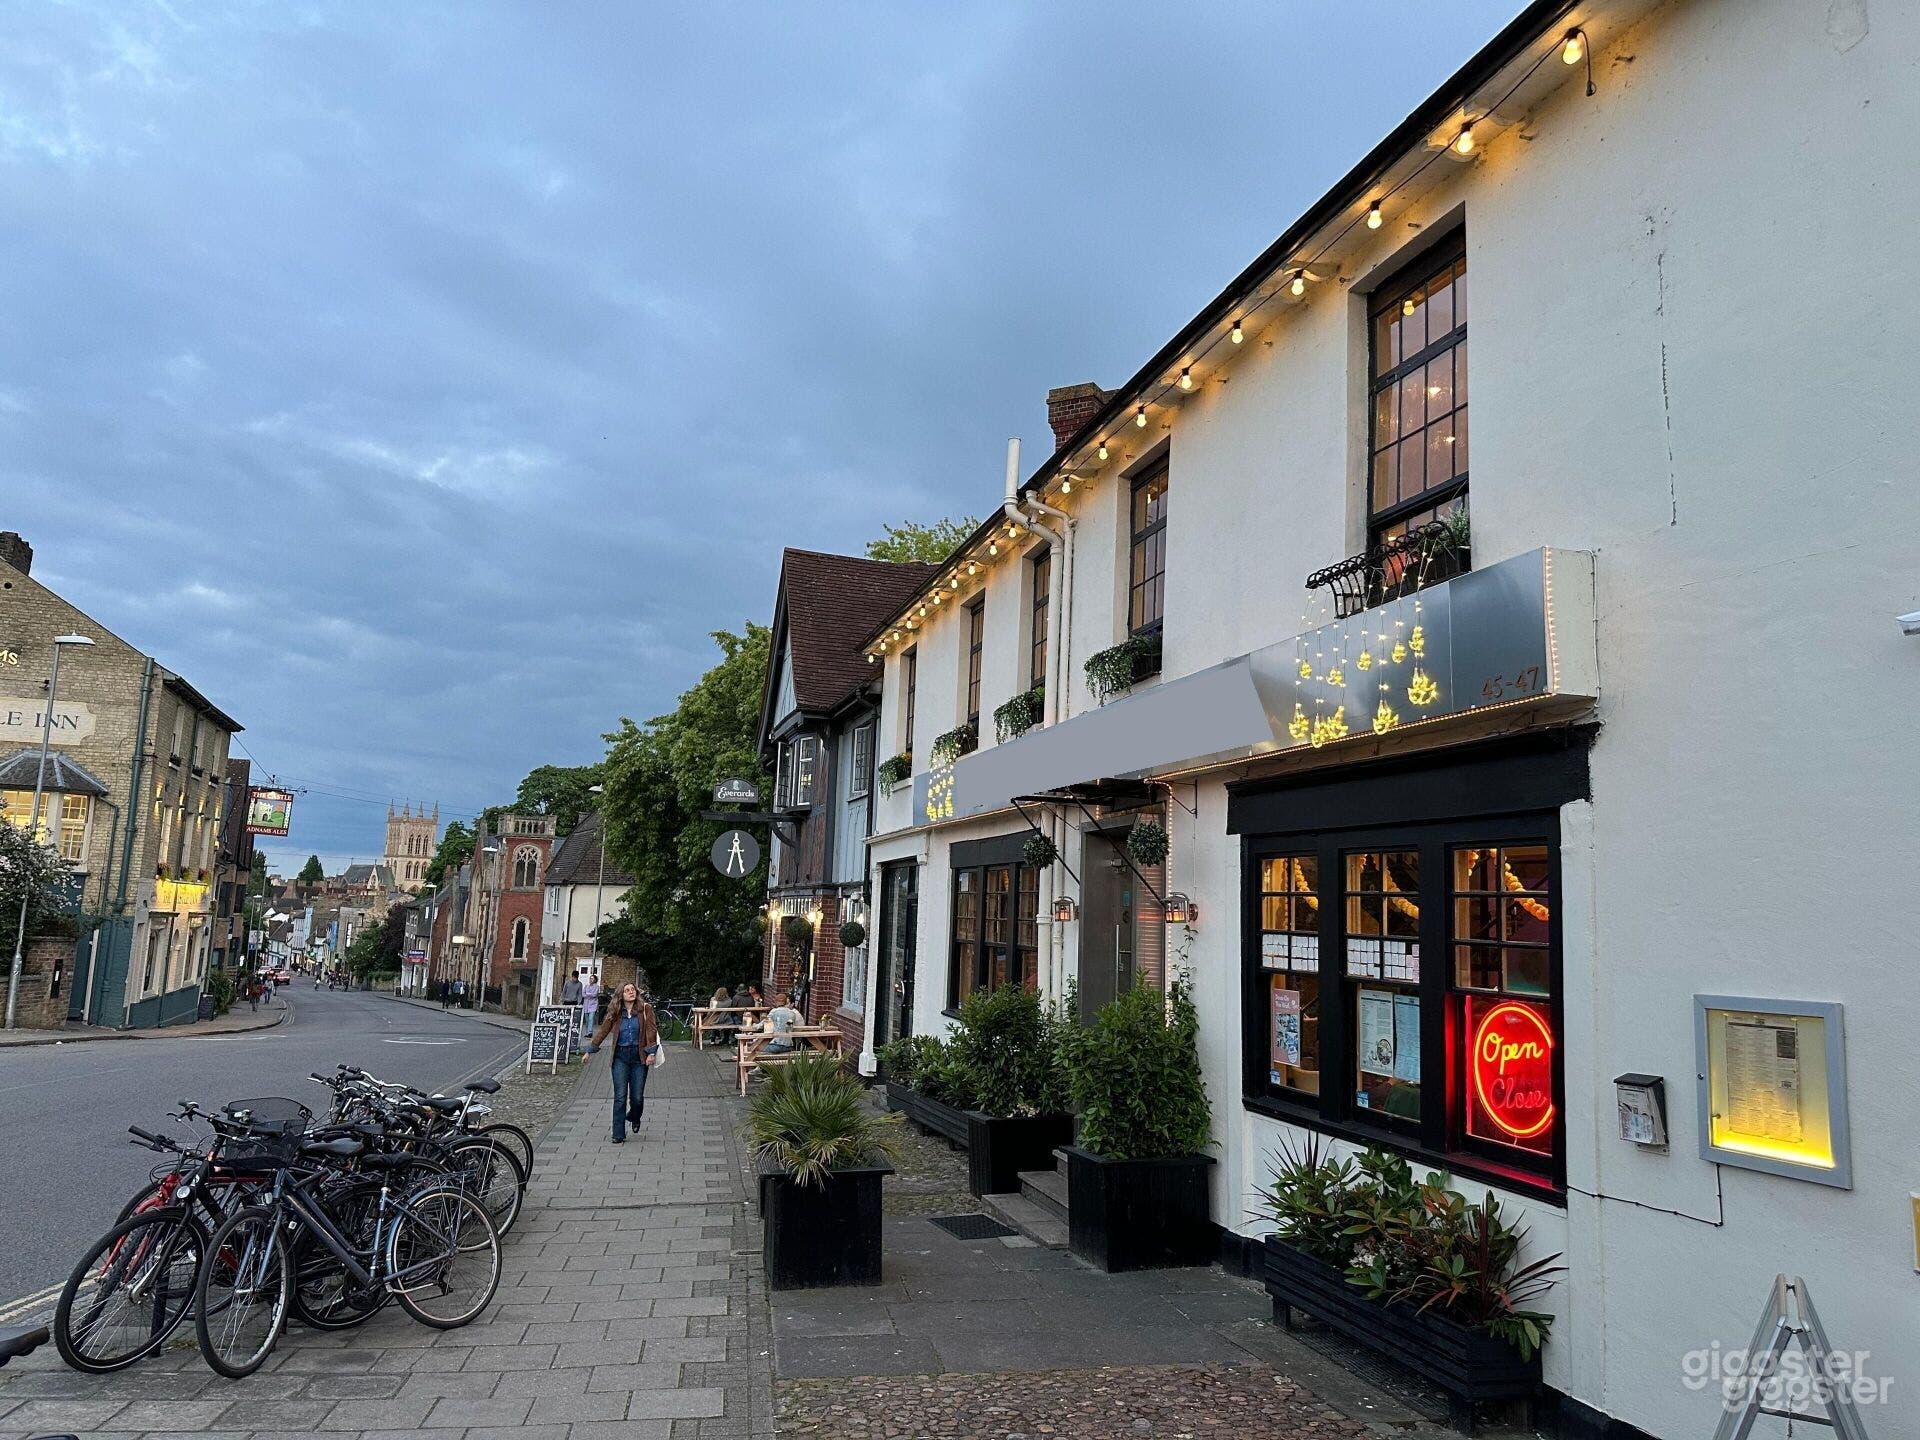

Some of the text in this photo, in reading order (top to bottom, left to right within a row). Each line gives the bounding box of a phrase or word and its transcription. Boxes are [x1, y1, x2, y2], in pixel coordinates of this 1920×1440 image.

[1482, 666, 1539, 698] 45-47
[0, 711, 80, 730] E INN
[267, 793, 292, 801] CASTLE
[717, 786, 755, 799] Everards
[1482, 1032, 1544, 1075] Open
[1491, 1077, 1547, 1110] Close
